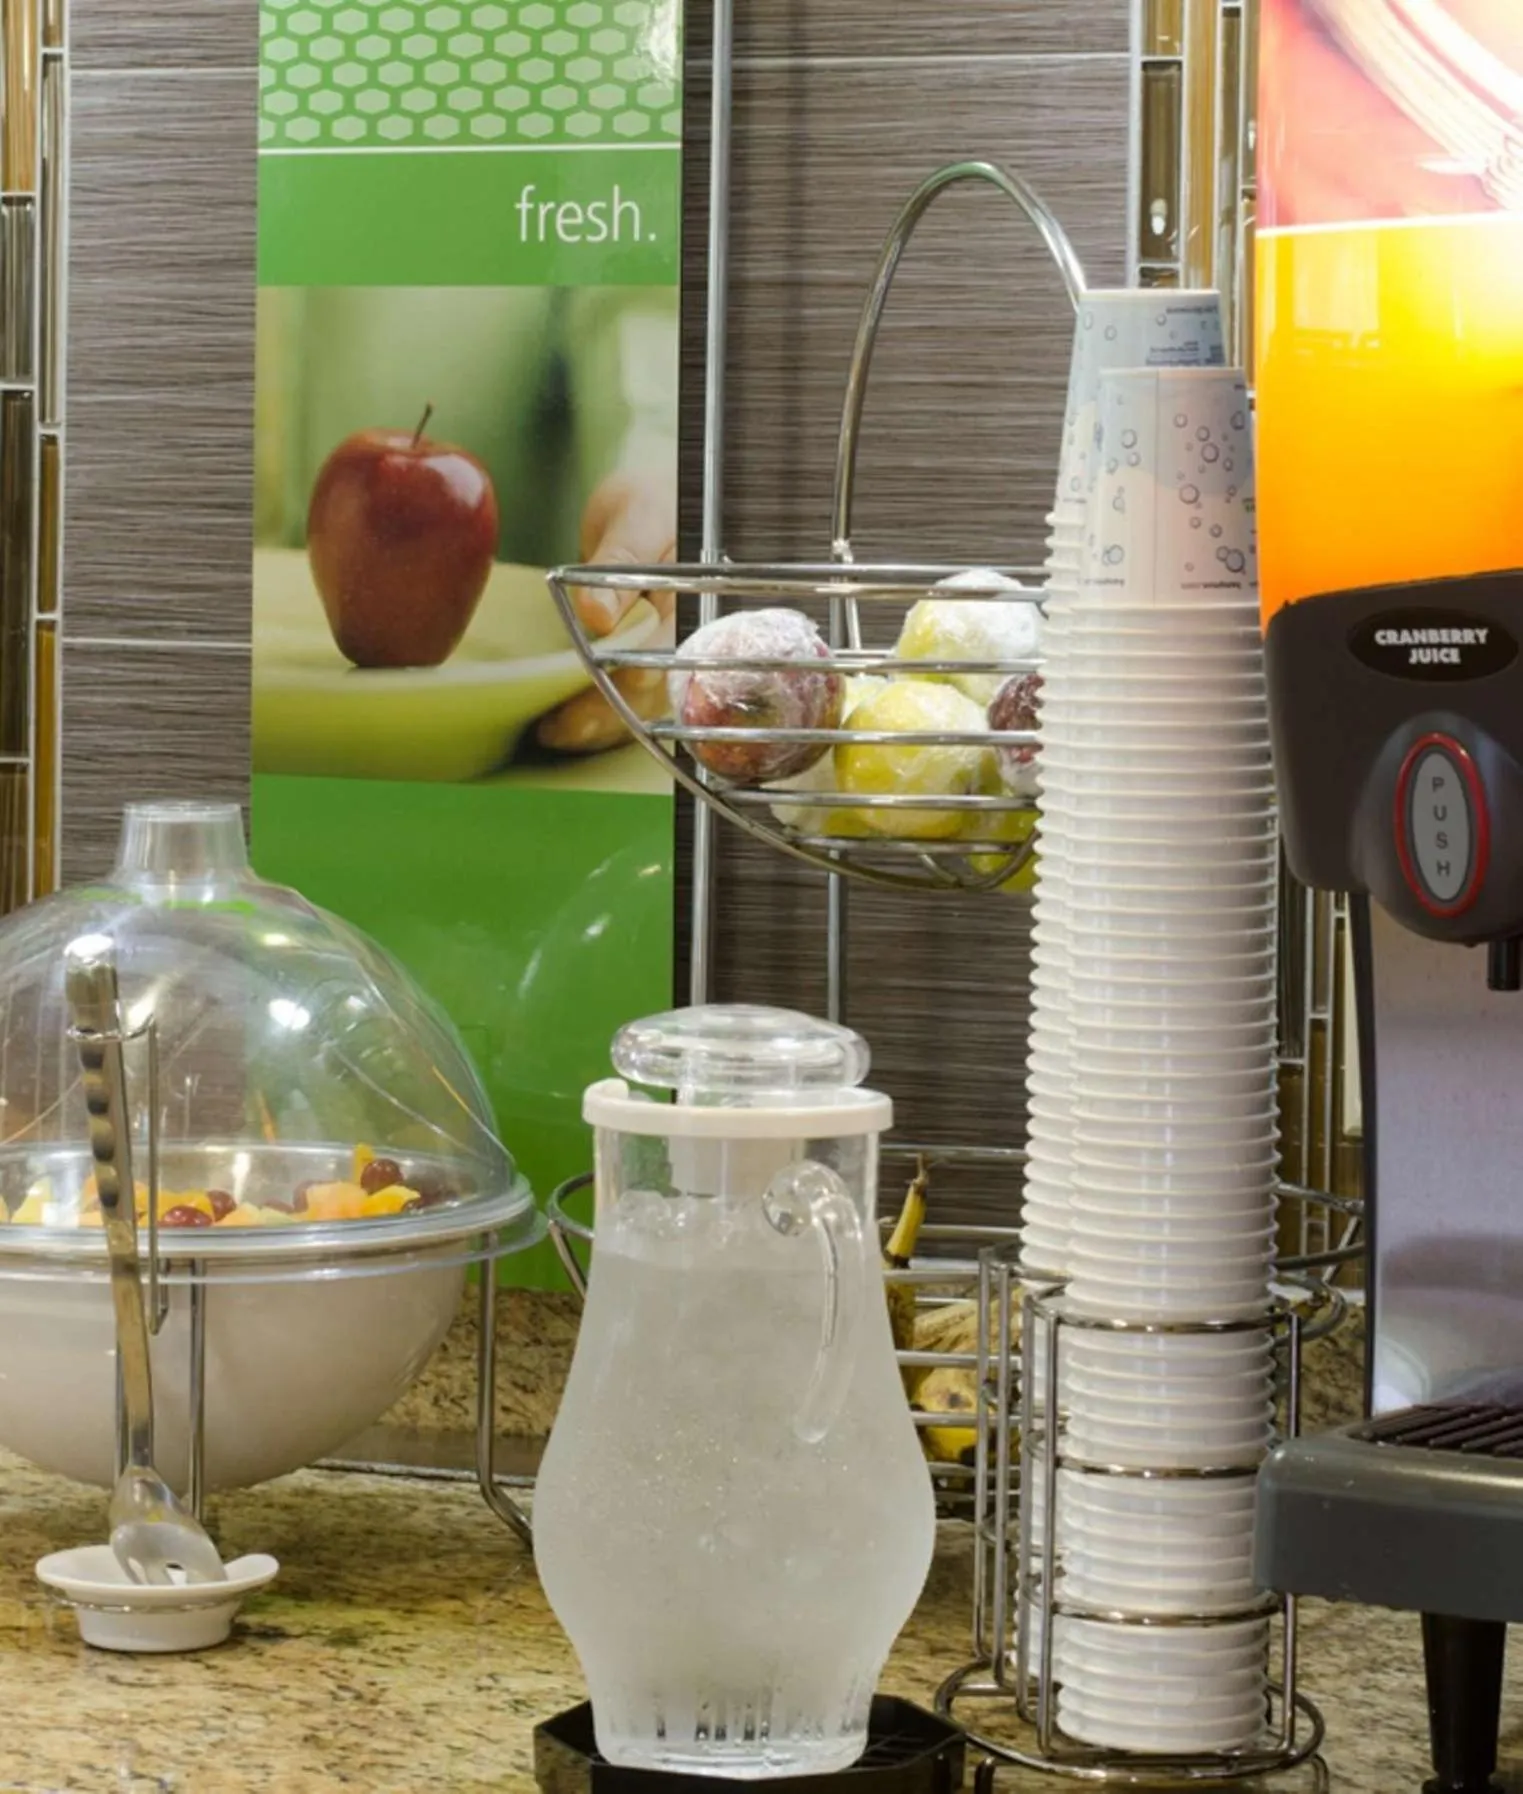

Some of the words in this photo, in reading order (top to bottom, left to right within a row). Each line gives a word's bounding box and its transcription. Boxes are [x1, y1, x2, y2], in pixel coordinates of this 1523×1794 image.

[513, 184, 656, 242] fresh.
[1375, 628, 1489, 645] CRANBERRY
[1409, 648, 1461, 664] JUICE
[1431, 777, 1450, 877] PUSH
